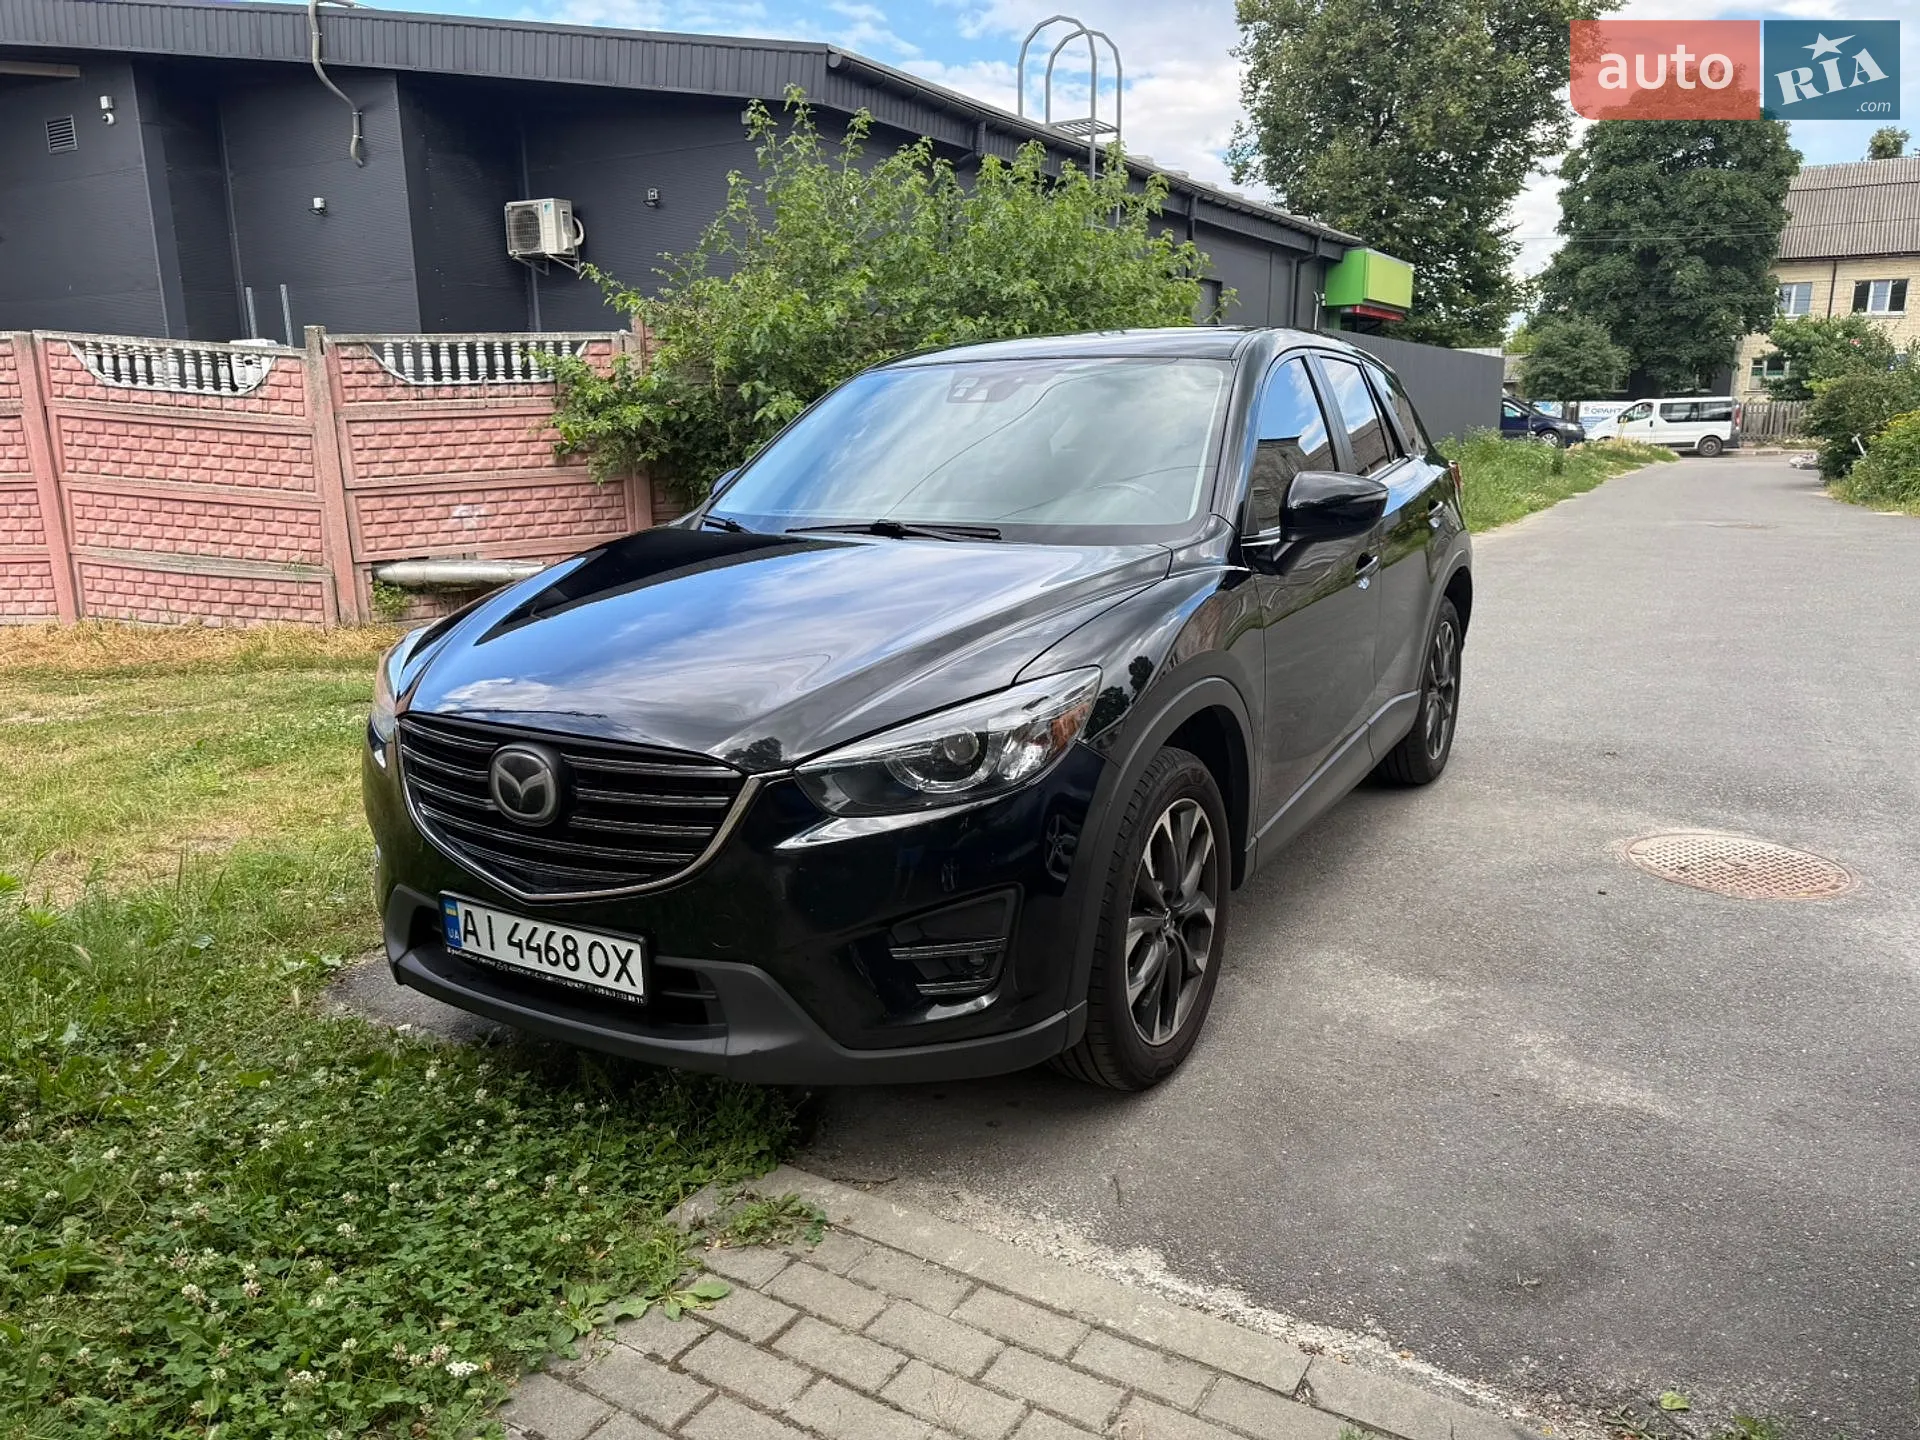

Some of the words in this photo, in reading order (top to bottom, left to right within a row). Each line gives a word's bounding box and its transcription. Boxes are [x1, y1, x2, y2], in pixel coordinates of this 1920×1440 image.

[447, 927, 460, 941] UA
[463, 909, 495, 951] AI
[507, 922, 580, 972] 4468
[588, 940, 637, 987] OX
